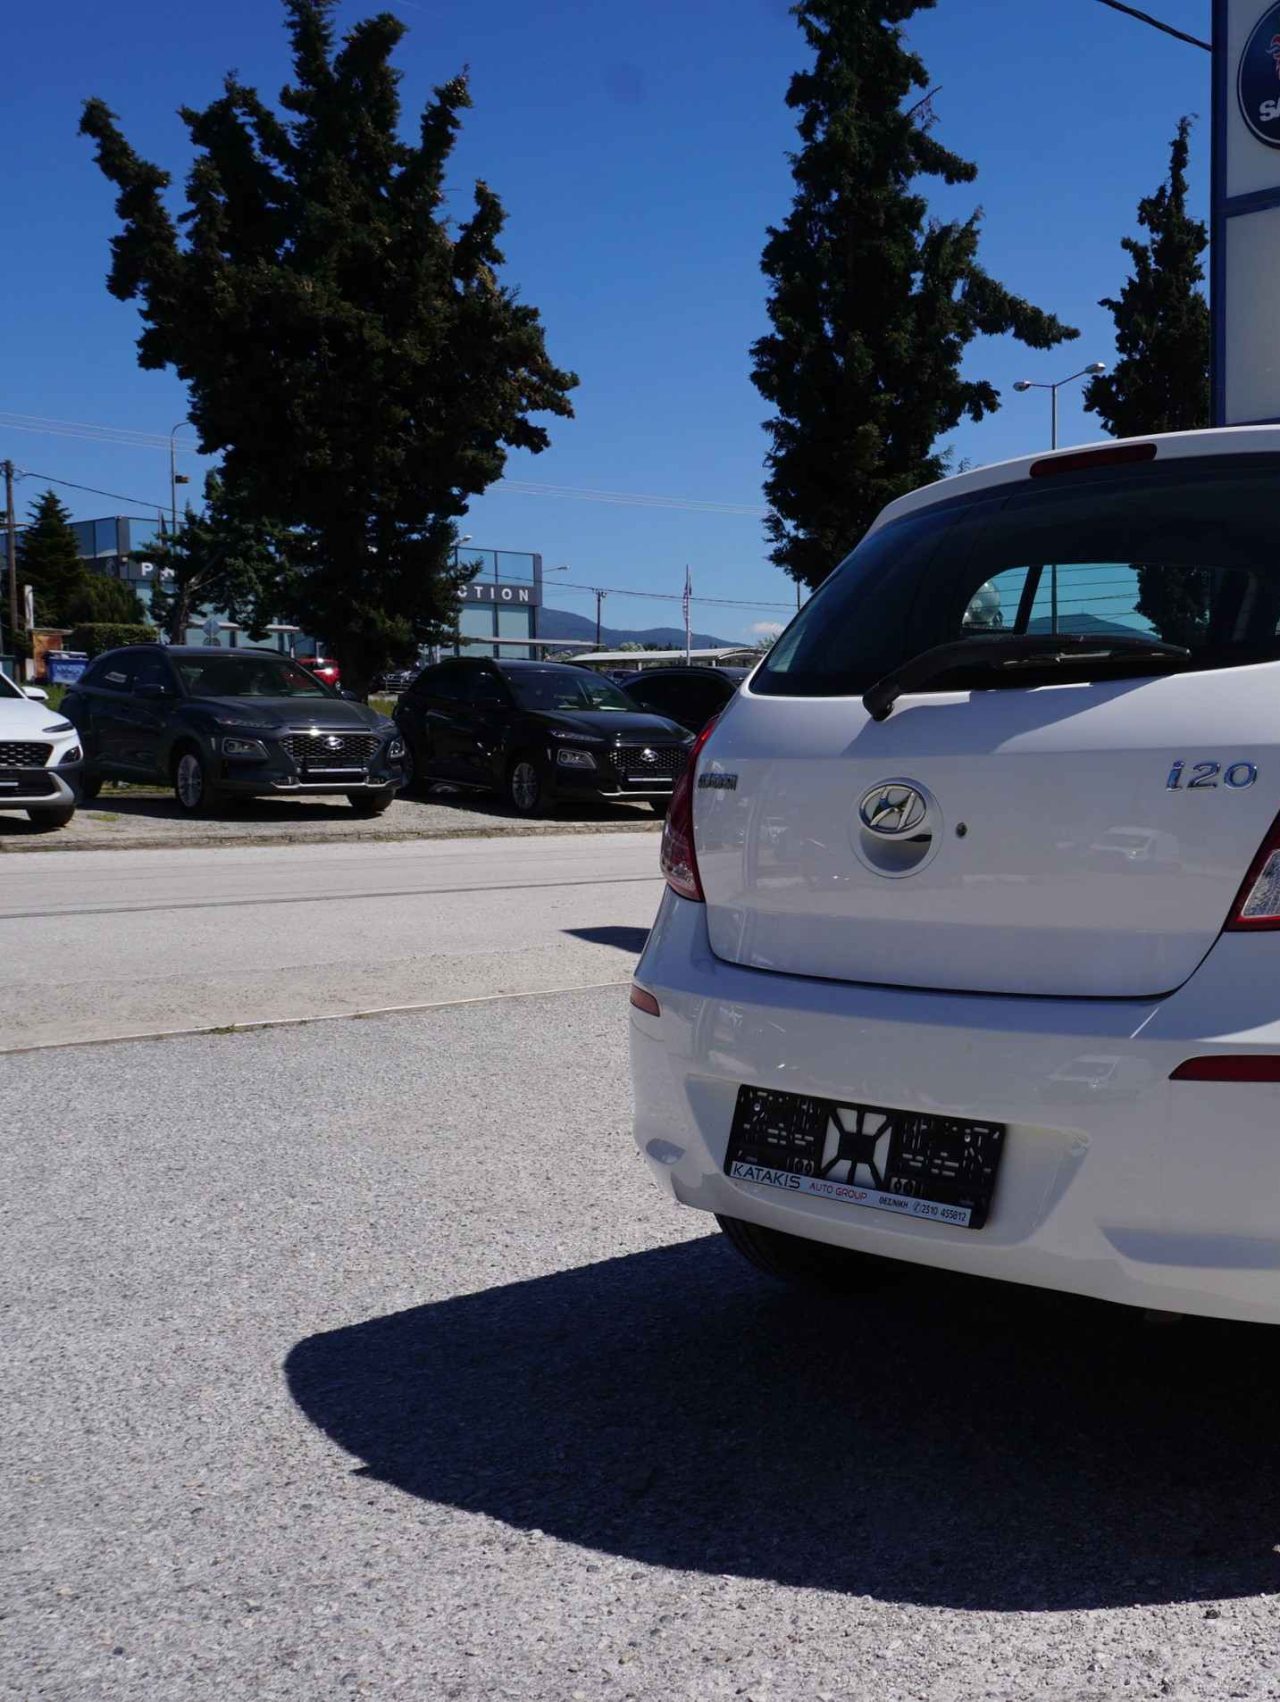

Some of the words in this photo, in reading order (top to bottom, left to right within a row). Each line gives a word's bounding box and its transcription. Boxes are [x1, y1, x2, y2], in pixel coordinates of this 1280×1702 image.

[1166, 760, 1258, 792] i20
[733, 1162, 801, 1189] KATAKIS
[809, 1182, 834, 1195] AUTO
[835, 1187, 868, 1200] GROUP
